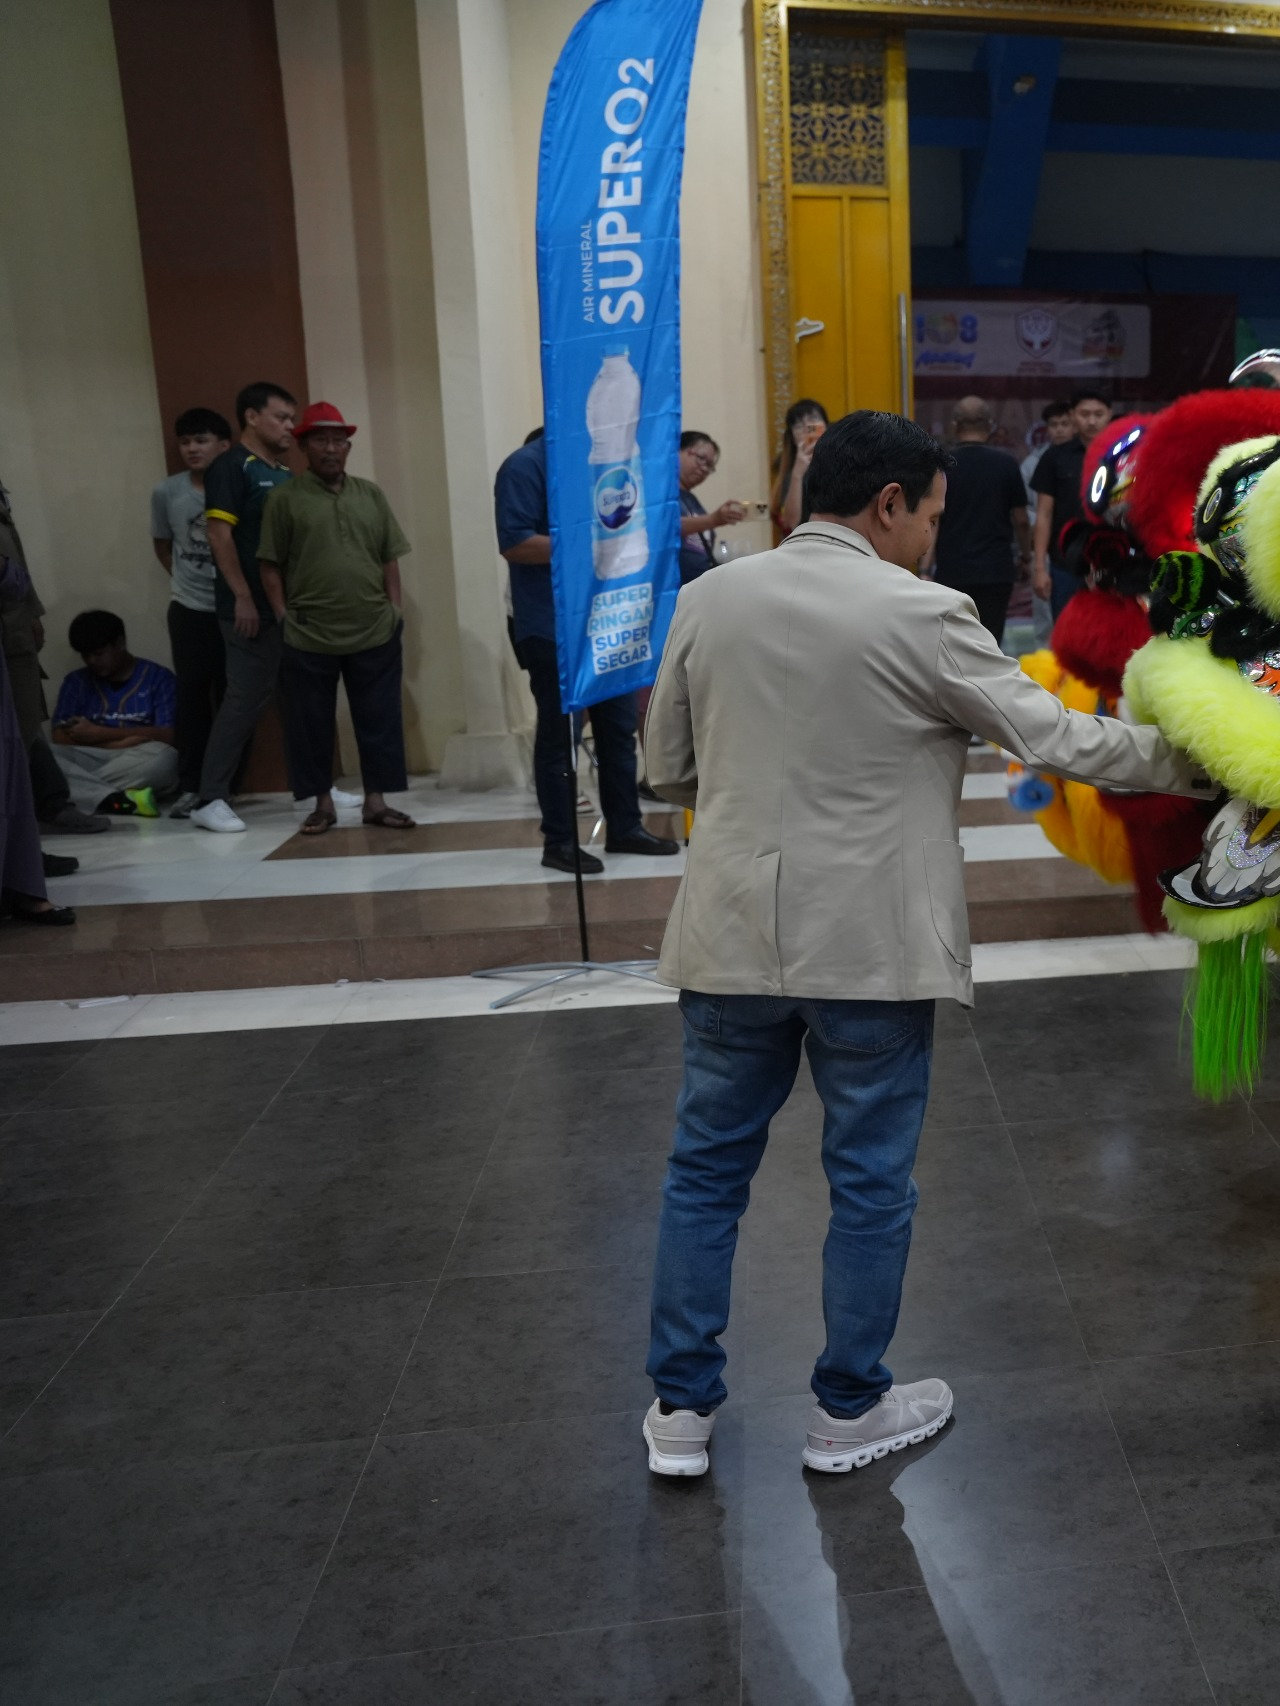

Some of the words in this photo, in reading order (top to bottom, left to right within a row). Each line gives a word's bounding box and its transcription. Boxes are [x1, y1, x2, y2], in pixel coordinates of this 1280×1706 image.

[596, 57, 655, 325] SUPERO2
[580, 219, 594, 293] MINERAL
[583, 295, 595, 324] AIR
[593, 586, 650, 611] SUPER
[589, 604, 653, 632] RINGAN
[595, 626, 649, 652] SUPER
[596, 645, 648, 671] SEGAR
